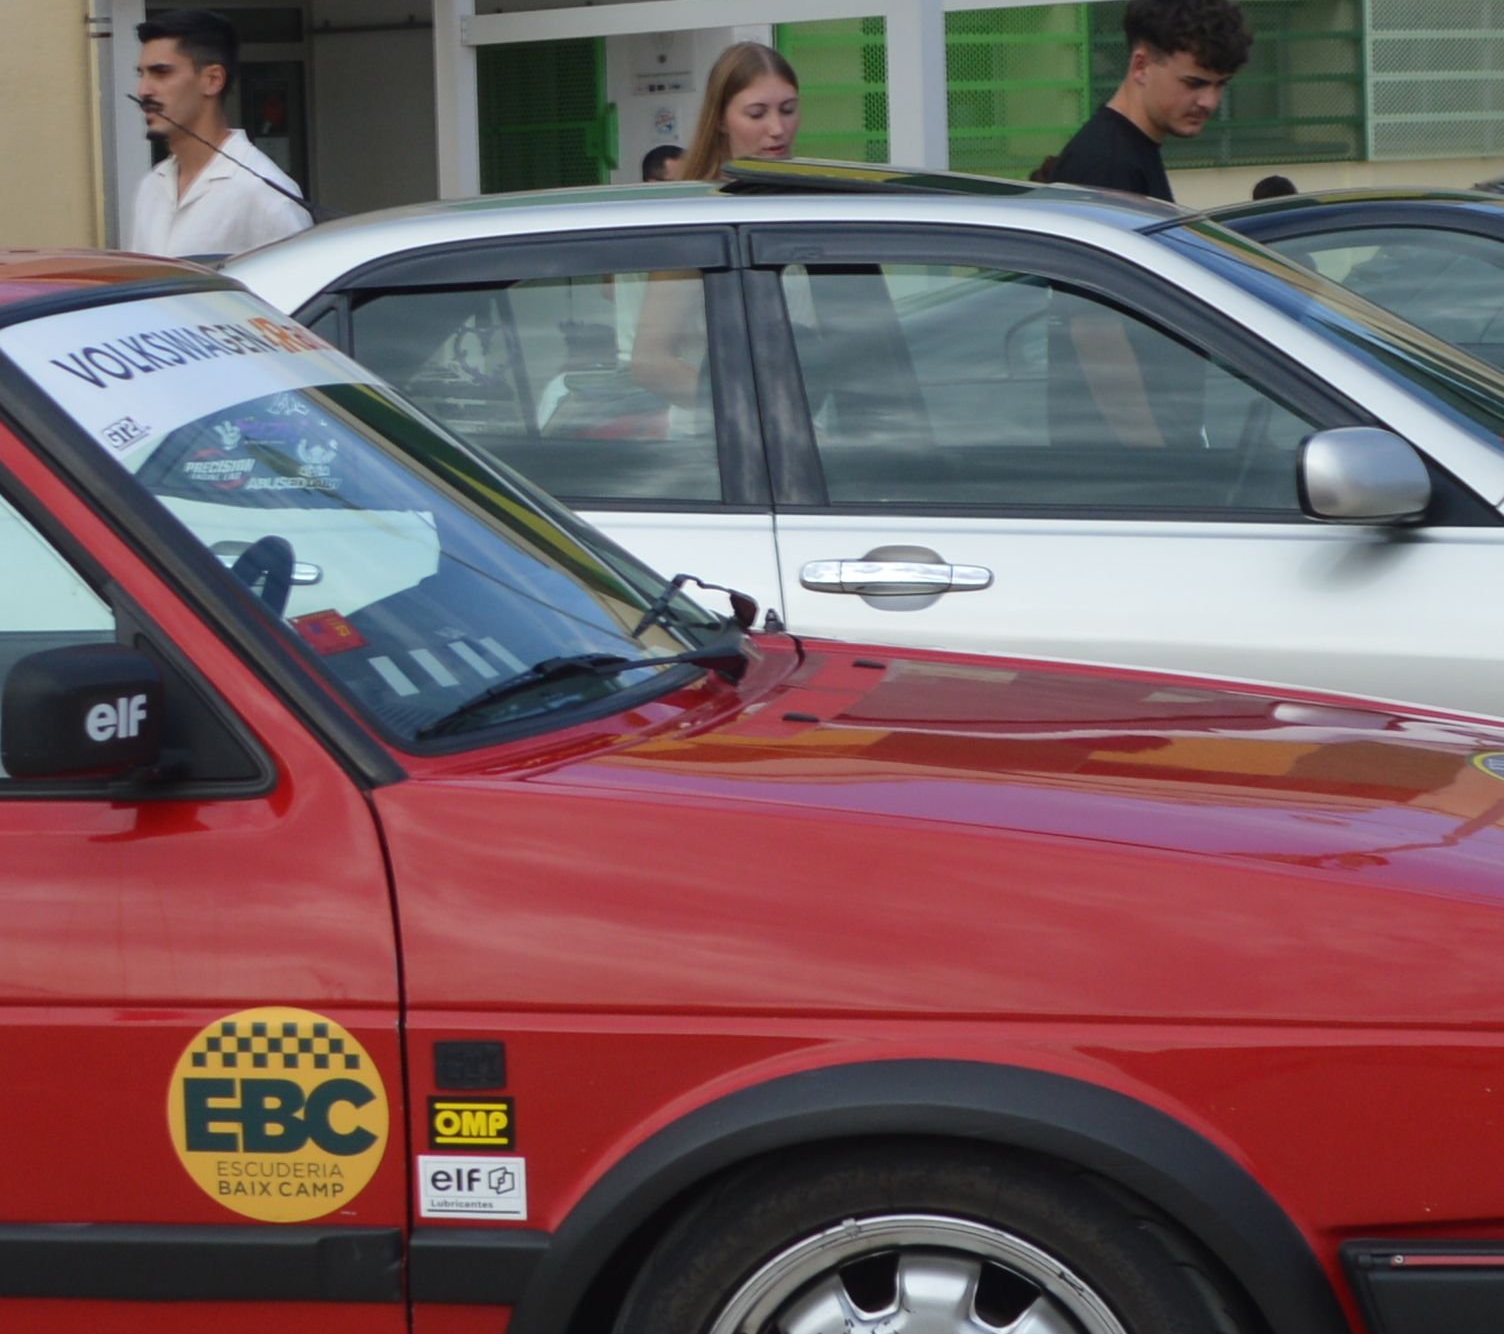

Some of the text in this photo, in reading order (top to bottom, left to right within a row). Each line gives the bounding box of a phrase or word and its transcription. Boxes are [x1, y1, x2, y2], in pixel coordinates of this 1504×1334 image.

[49, 324, 278, 389] VOLKSWAGEN
[85, 694, 147, 742] elf
[183, 1077, 379, 1157] EBC
[434, 1109, 509, 1138] OMP
[216, 1160, 345, 1180] ESCUDERIA
[431, 1168, 482, 1193] elf
[218, 1179, 345, 1199] BAIX CAMP
[430, 1198, 495, 1211] Lubricantes
